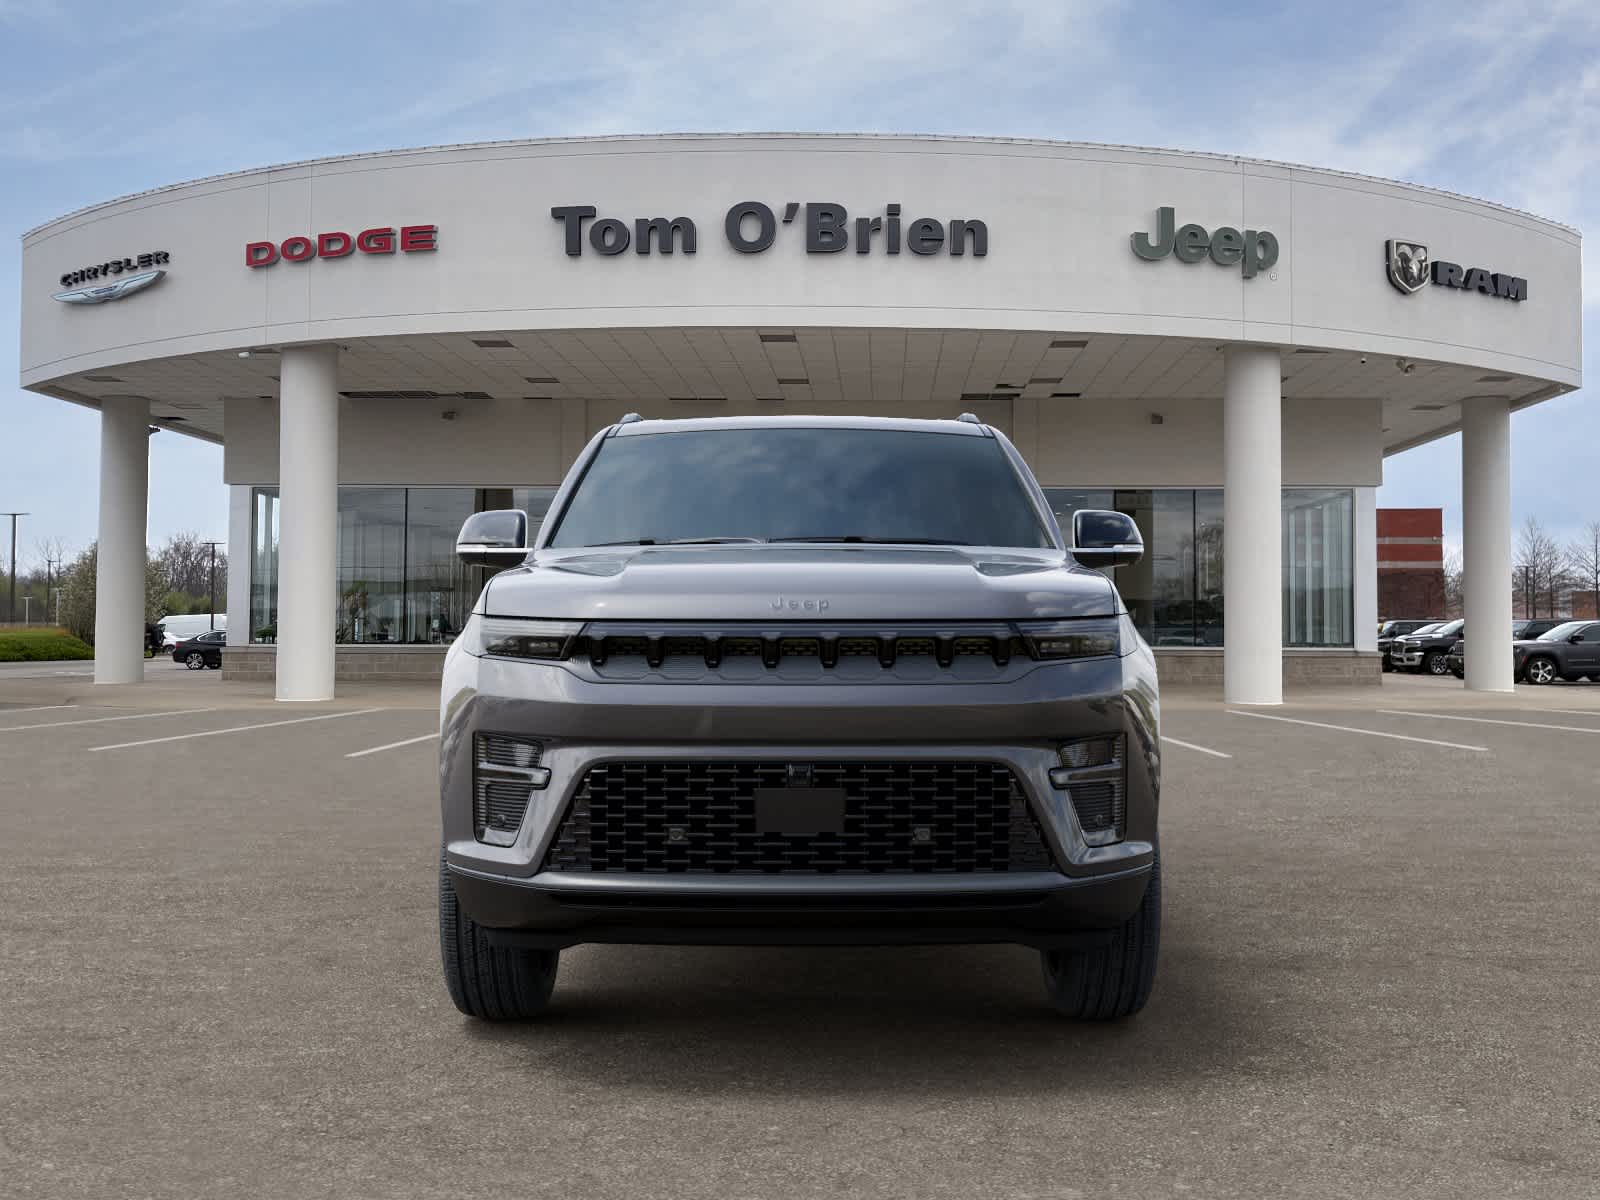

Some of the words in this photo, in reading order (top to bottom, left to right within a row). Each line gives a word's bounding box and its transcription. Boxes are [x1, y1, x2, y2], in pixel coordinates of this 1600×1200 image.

[246, 225, 438, 270] DODGE
[551, 205, 697, 257] Tom
[1130, 206, 1280, 279] Jeep
[60, 250, 170, 287] CHRYSLER
[1432, 260, 1528, 302] RAM
[768, 592, 831, 615] Jeep
